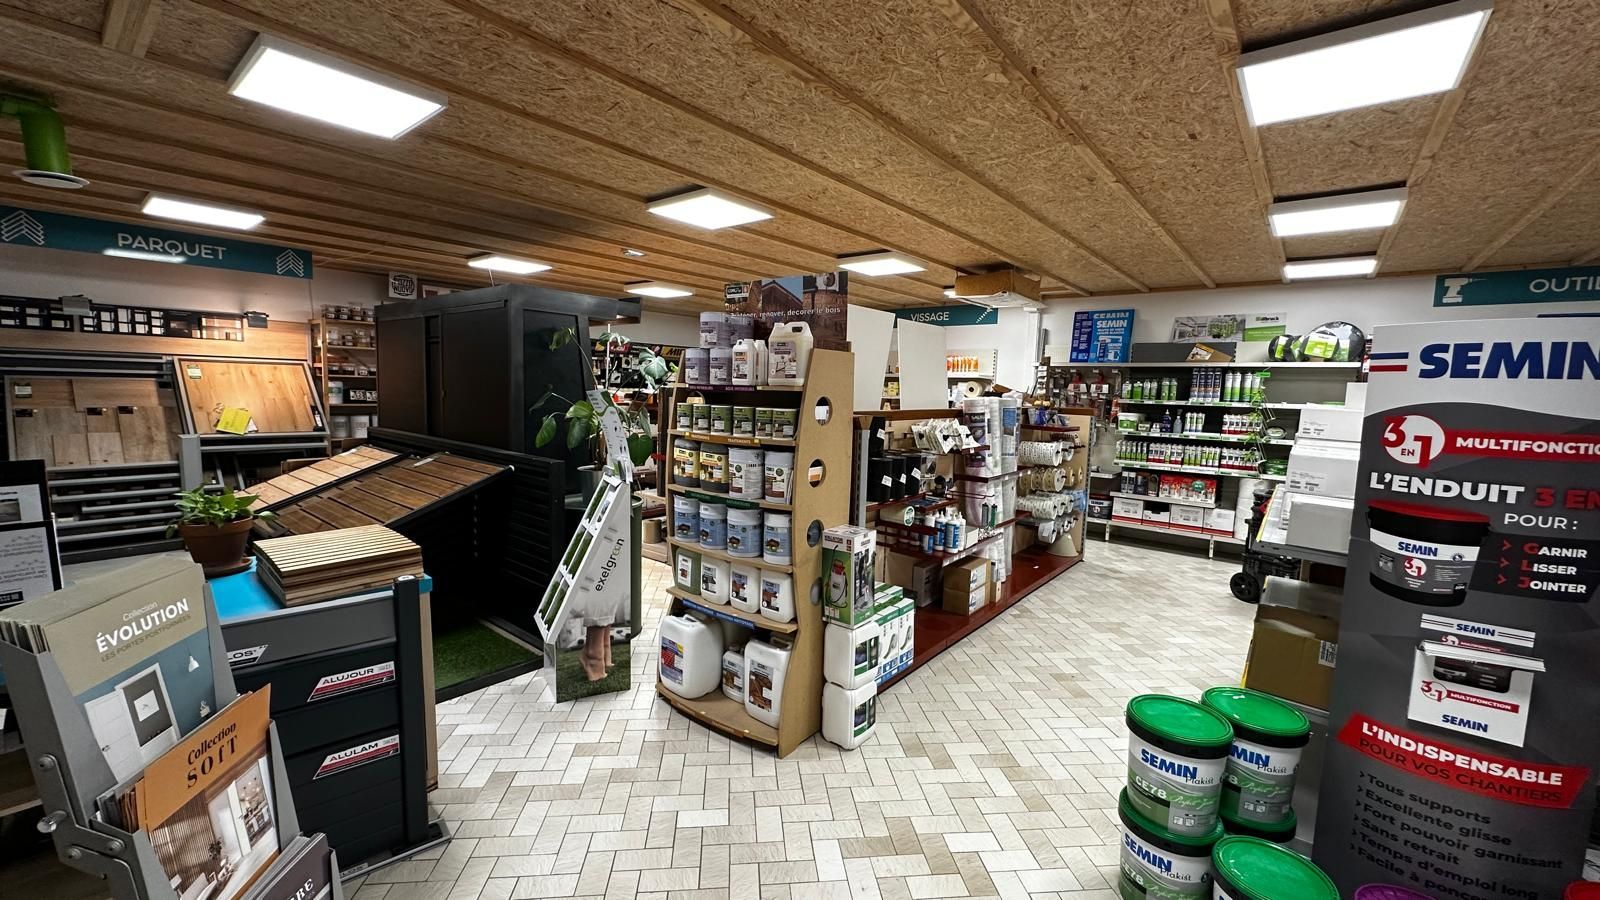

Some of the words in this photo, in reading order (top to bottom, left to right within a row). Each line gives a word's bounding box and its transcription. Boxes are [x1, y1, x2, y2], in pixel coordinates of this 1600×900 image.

[117, 233, 227, 260] PARQUET
[910, 312, 950, 322] VISSAGE
[1096, 319, 1128, 328] SEMIN
[1418, 341, 1600, 381] SEMIN
[1400, 448, 1415, 457] EN
[1534, 487, 1556, 507] 3
[1504, 512, 1568, 530] POUR
[1398, 541, 1439, 557] SEMIN
[1523, 542, 1588, 559] GARNIR
[1520, 559, 1577, 576] LISSER
[1518, 576, 1587, 594] JOINTER
[122, 601, 158, 622] Collection
[96, 598, 190, 653] ÉVOLUTION
[1456, 623, 1496, 637] SEMIN
[322, 668, 375, 685] ALUJOUR
[1450, 692, 1512, 711] MULTIFONCTION
[1442, 714, 1489, 733] SEMIN
[187, 721, 237, 766] Collection
[329, 742, 379, 762] ALULAM
[1361, 721, 1564, 786] L'INDISPENSABLE
[1141, 748, 1198, 780] SEMIN
[1359, 738, 1408, 768] POUR
[1411, 758, 1450, 780] VOS
[1455, 773, 1563, 803] CHANTIERS
[1135, 775, 1167, 800] CE78
[1367, 773, 1405, 797] Tous
[1408, 791, 1491, 825] supports
[1364, 789, 1454, 832] Excellente
[1458, 826, 1514, 846] glisse
[1358, 831, 1414, 864] Temps
[1360, 818, 1399, 843] Sans
[1403, 839, 1461, 866] retrait
[1363, 803, 1397, 826] Fort
[1400, 819, 1471, 852] pouvoir
[1473, 845, 1564, 870] garnissant
[1124, 833, 1173, 873] SEMIN
[1357, 848, 1406, 877] Facile
[1409, 871, 1421, 883] à
